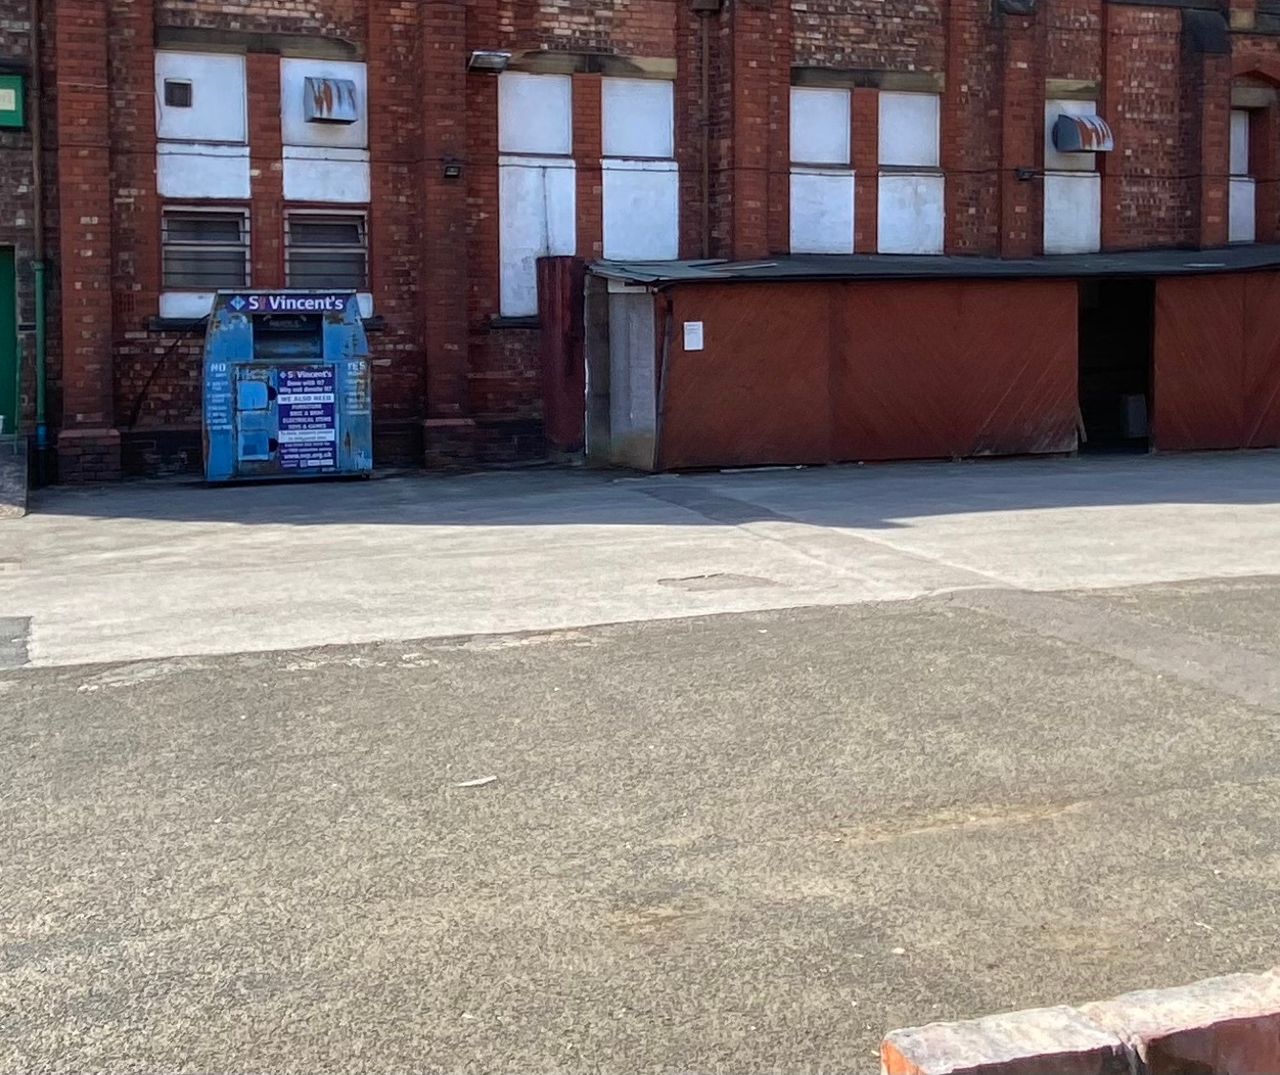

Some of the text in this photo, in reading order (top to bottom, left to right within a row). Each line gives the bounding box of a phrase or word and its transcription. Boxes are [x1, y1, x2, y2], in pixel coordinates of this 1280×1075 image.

[269, 295, 344, 310] Vincent's
[210, 363, 226, 372] NO
[347, 361, 366, 371] YES
[296, 371, 332, 379] Vincent's
